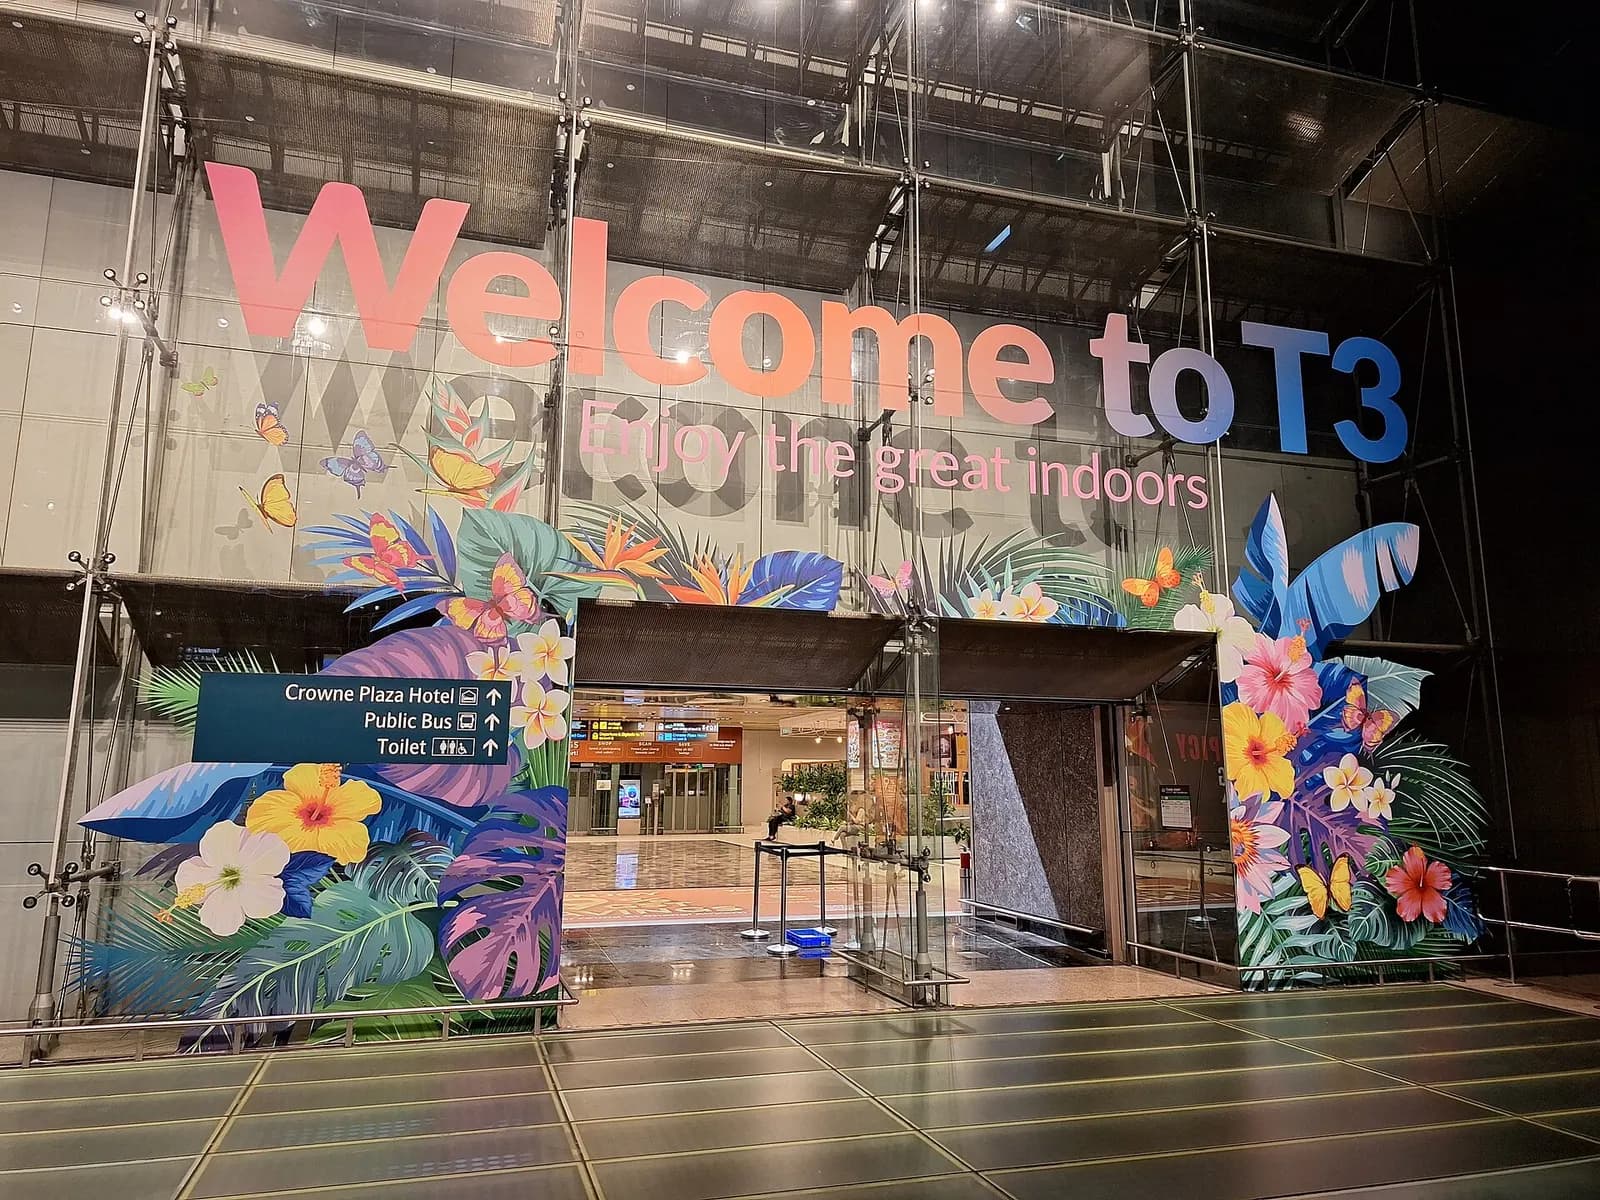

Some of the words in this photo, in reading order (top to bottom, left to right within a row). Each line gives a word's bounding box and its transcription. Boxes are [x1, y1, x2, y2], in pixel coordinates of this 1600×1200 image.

[204, 161, 1055, 425] Welcome
[1089, 312, 1235, 444] to
[1241, 320, 1408, 463] T3
[580, 399, 745, 475] Enjoy
[767, 420, 855, 478] the
[874, 445, 1011, 494] great
[1028, 446, 1208, 509] indoors
[285, 683, 354, 702] Crowne
[359, 685, 403, 703] Plaza
[409, 686, 454, 704] Hotel
[364, 711, 417, 729] Public
[421, 712, 452, 729] Bus
[377, 737, 426, 755] Toilet
